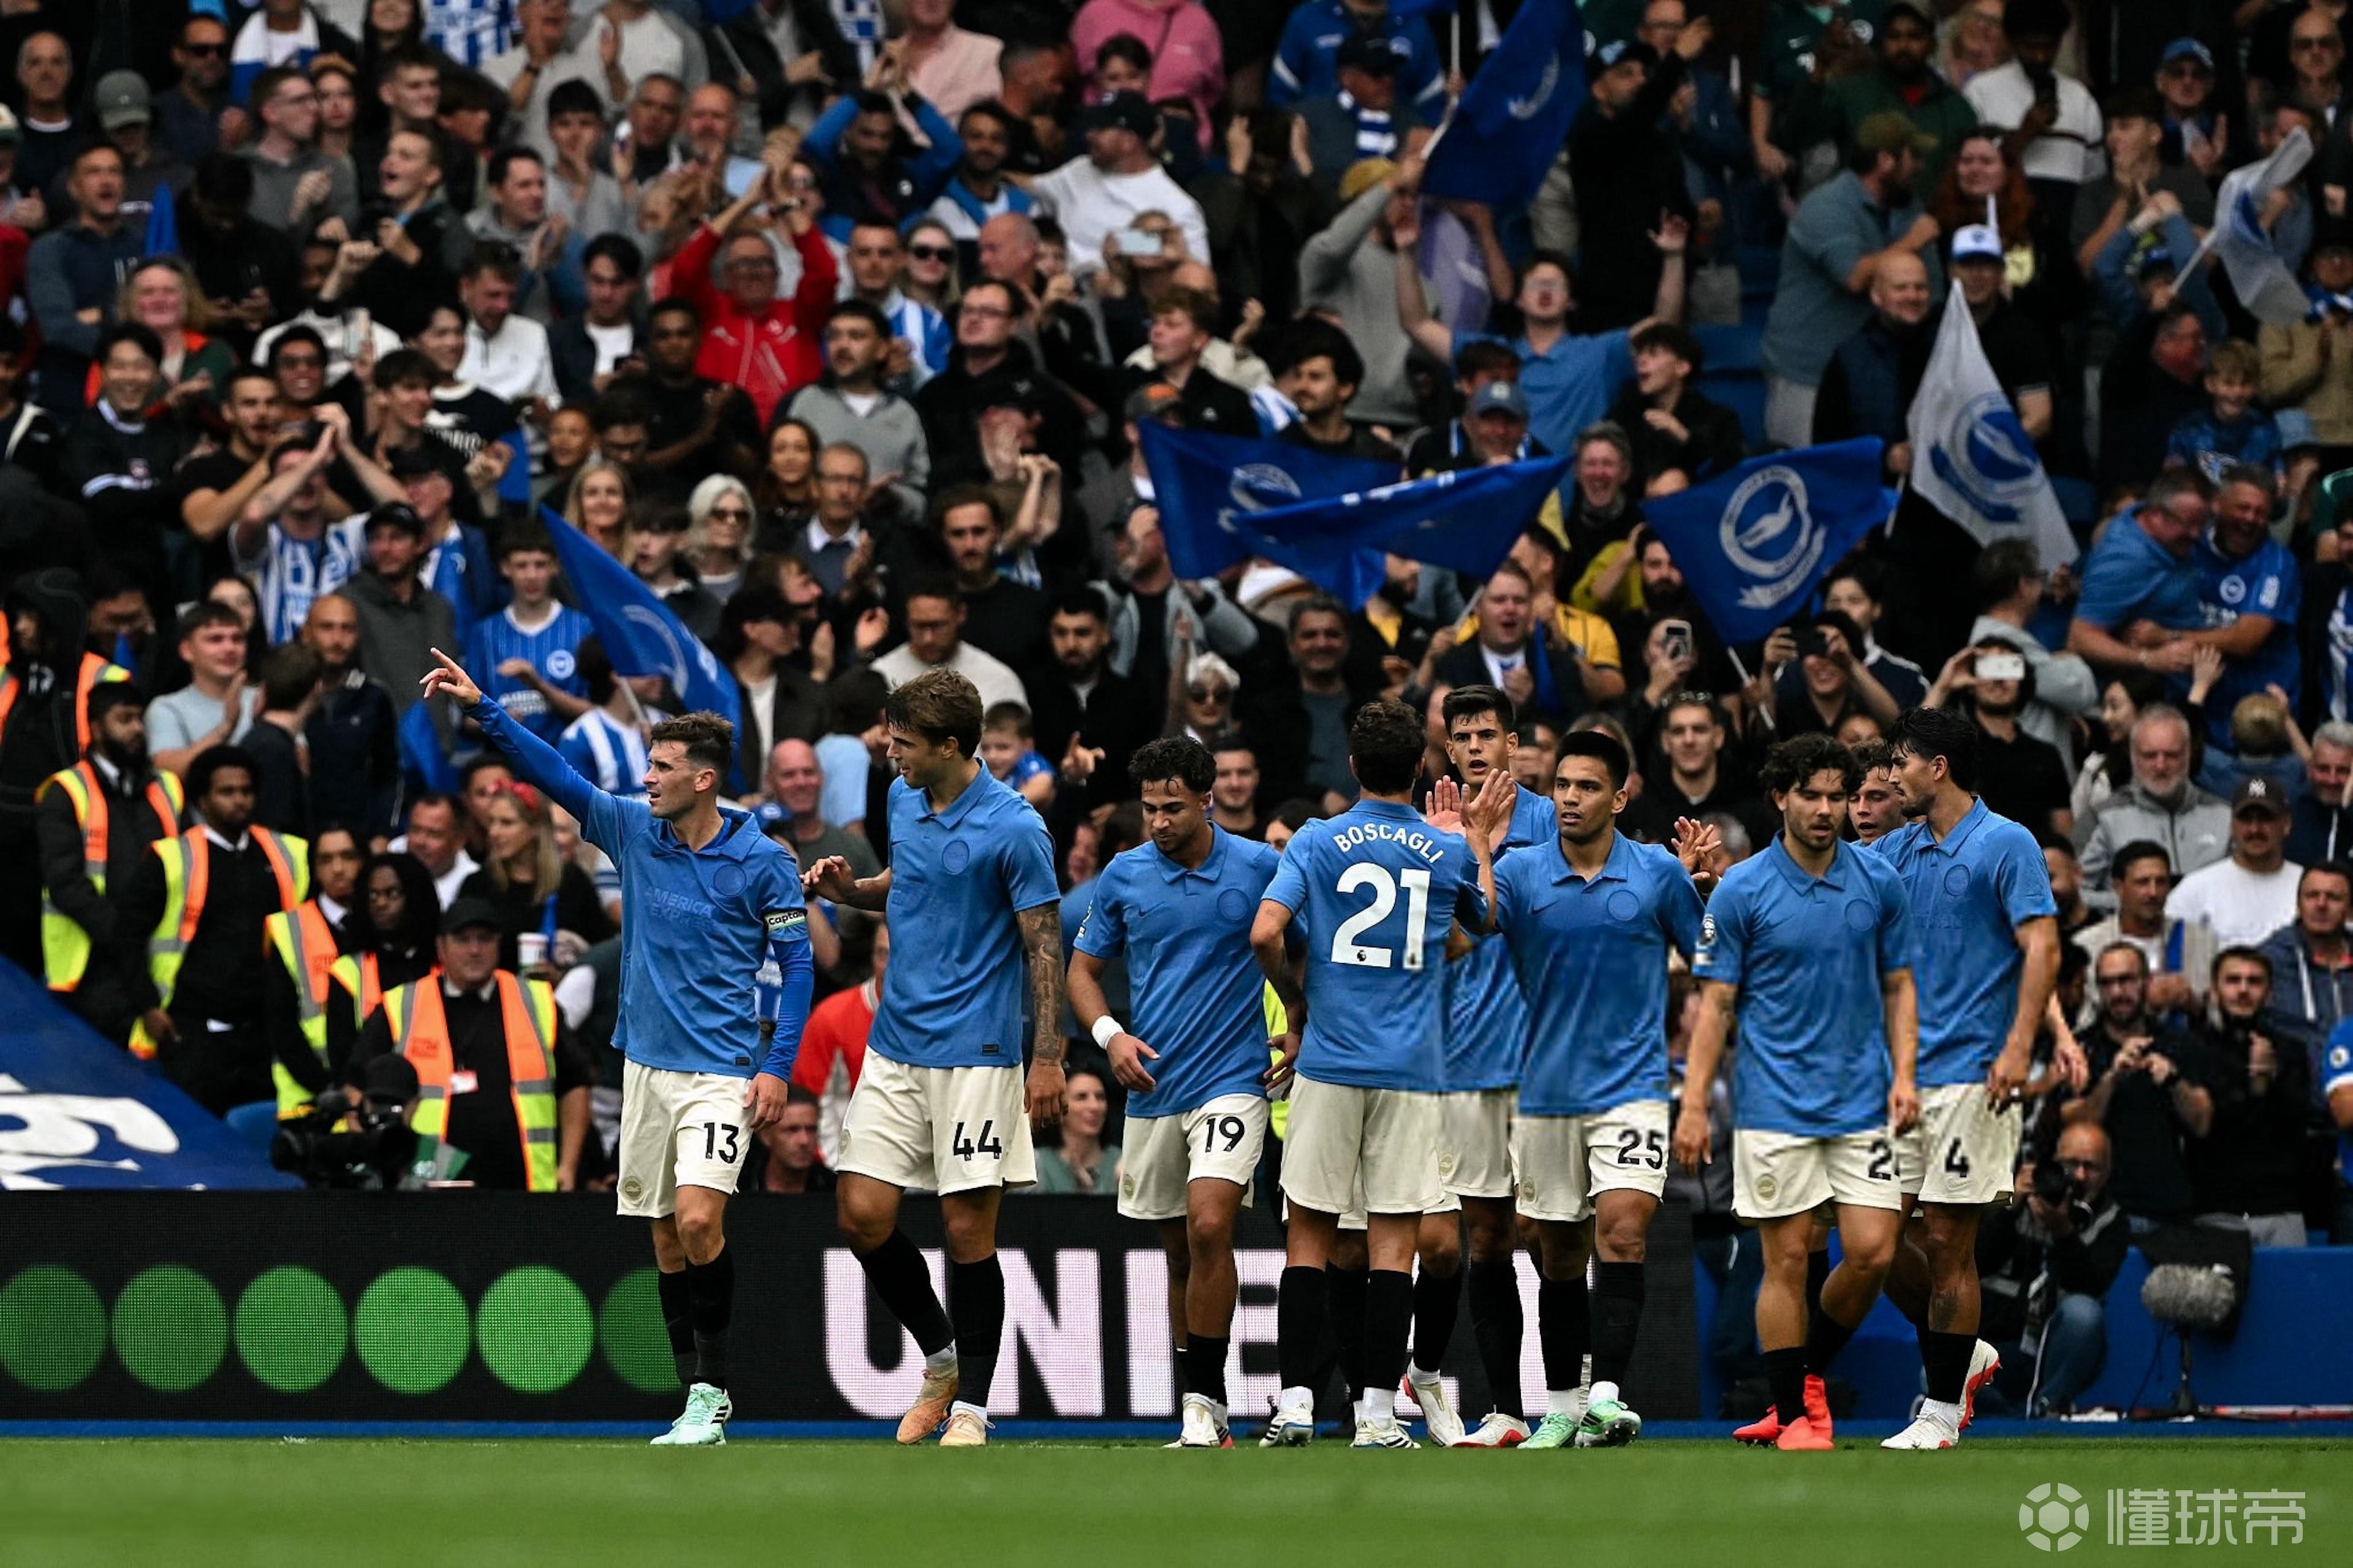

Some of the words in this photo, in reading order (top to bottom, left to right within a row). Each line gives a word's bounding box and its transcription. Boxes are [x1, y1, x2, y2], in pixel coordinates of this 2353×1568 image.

[1333, 823, 1444, 863] BOSCAGLI
[1331, 862, 1431, 969] 21
[704, 1122, 739, 1164] 13
[953, 1120, 1002, 1161] 44
[1205, 1116, 1245, 1153] 19
[1618, 1129, 1665, 1170] 25
[1869, 1138, 1900, 1181] 2
[1946, 1137, 1969, 1178] 4
